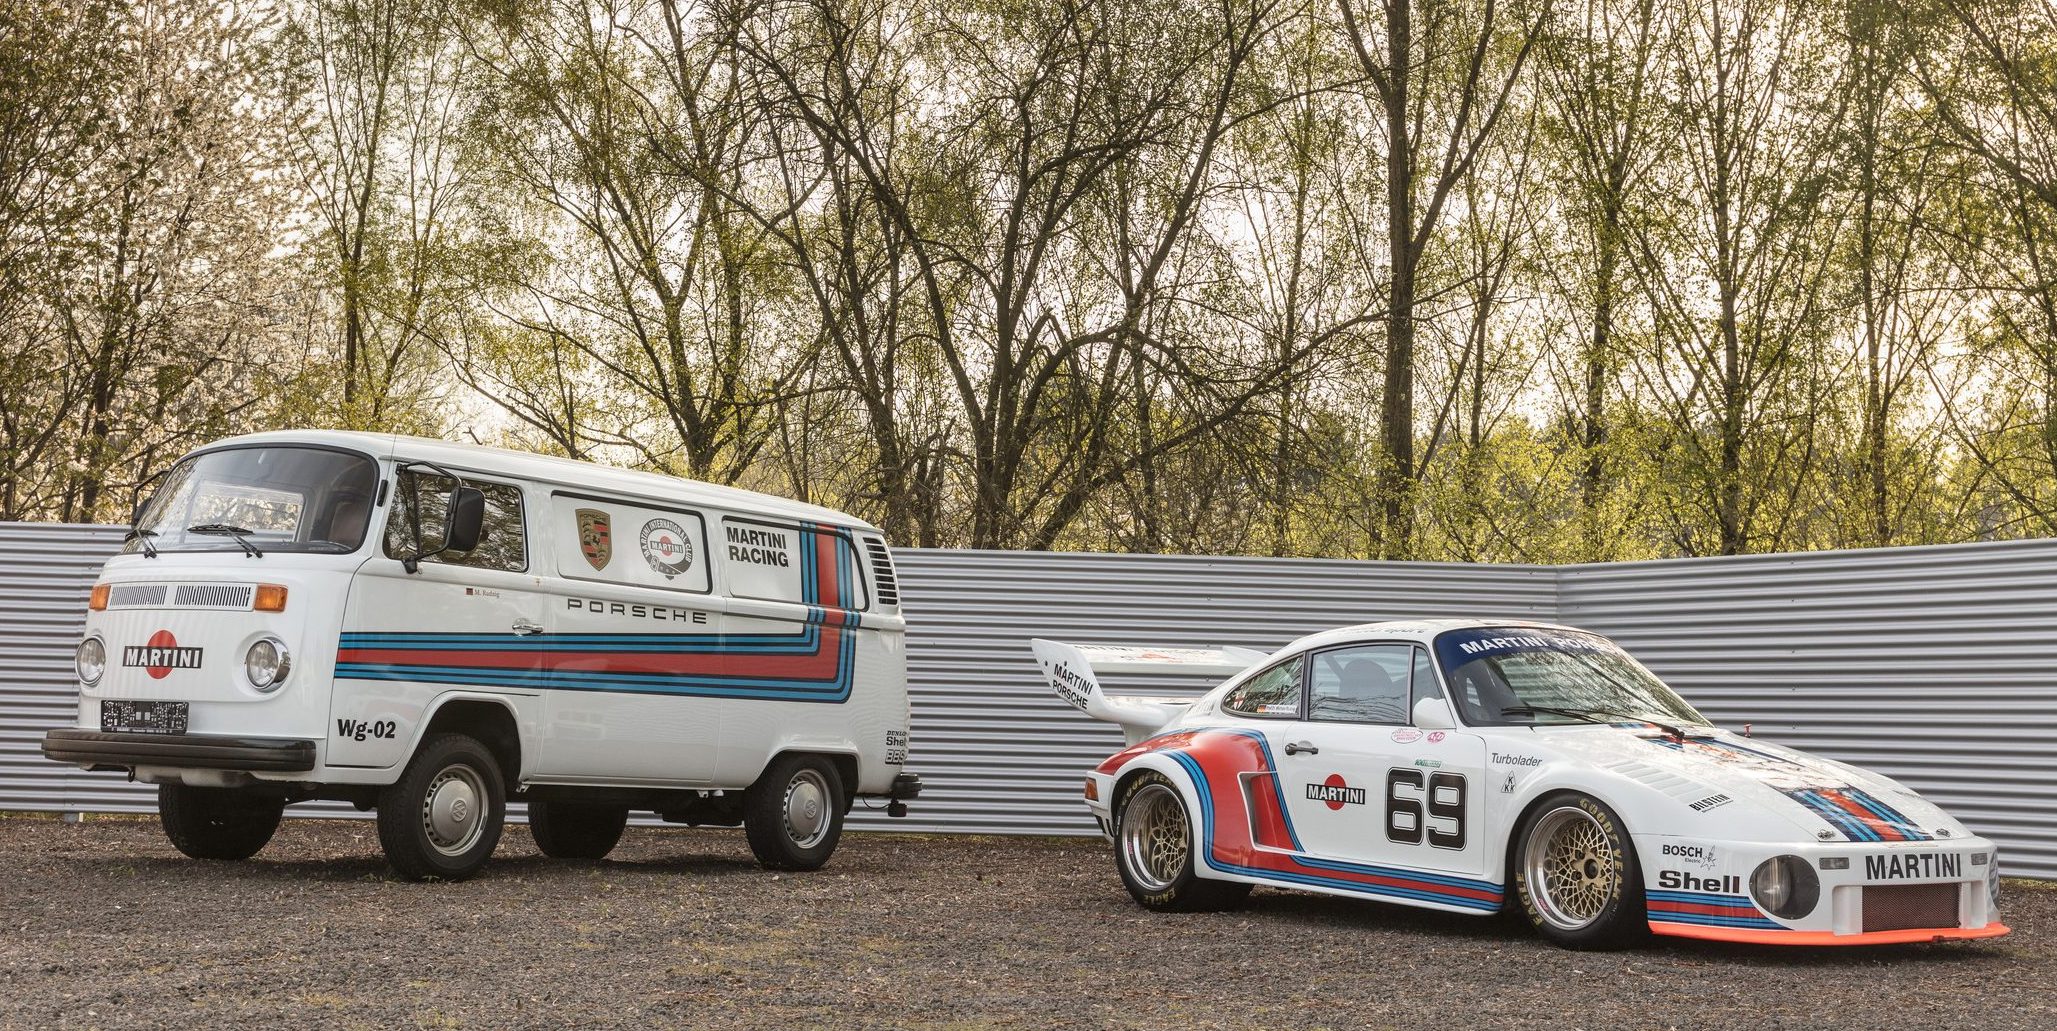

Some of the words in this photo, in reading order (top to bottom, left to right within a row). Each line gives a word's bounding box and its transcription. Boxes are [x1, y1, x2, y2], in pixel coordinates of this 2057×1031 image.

[651, 541, 682, 552] MARTINI
[726, 526, 787, 550] MARTINI
[728, 545, 789, 568] RACING
[567, 598, 707, 625] PORSCHE
[1460, 636, 1549, 655] MARTINI
[126, 648, 200, 668] MARTINI
[1054, 663, 1094, 696] MARTINI
[1052, 679, 1089, 710] PORSCHE
[337, 718, 396, 742] Wg-02
[1491, 752, 1543, 767] Turbolader
[1307, 785, 1364, 804] MARTINI
[1688, 793, 1731, 812] BILSTEIN
[1385, 766, 1469, 851] 69
[1662, 844, 1703, 858] BOSCH
[1865, 853, 1962, 880] MARTINI
[1658, 870, 1740, 894] Shell
